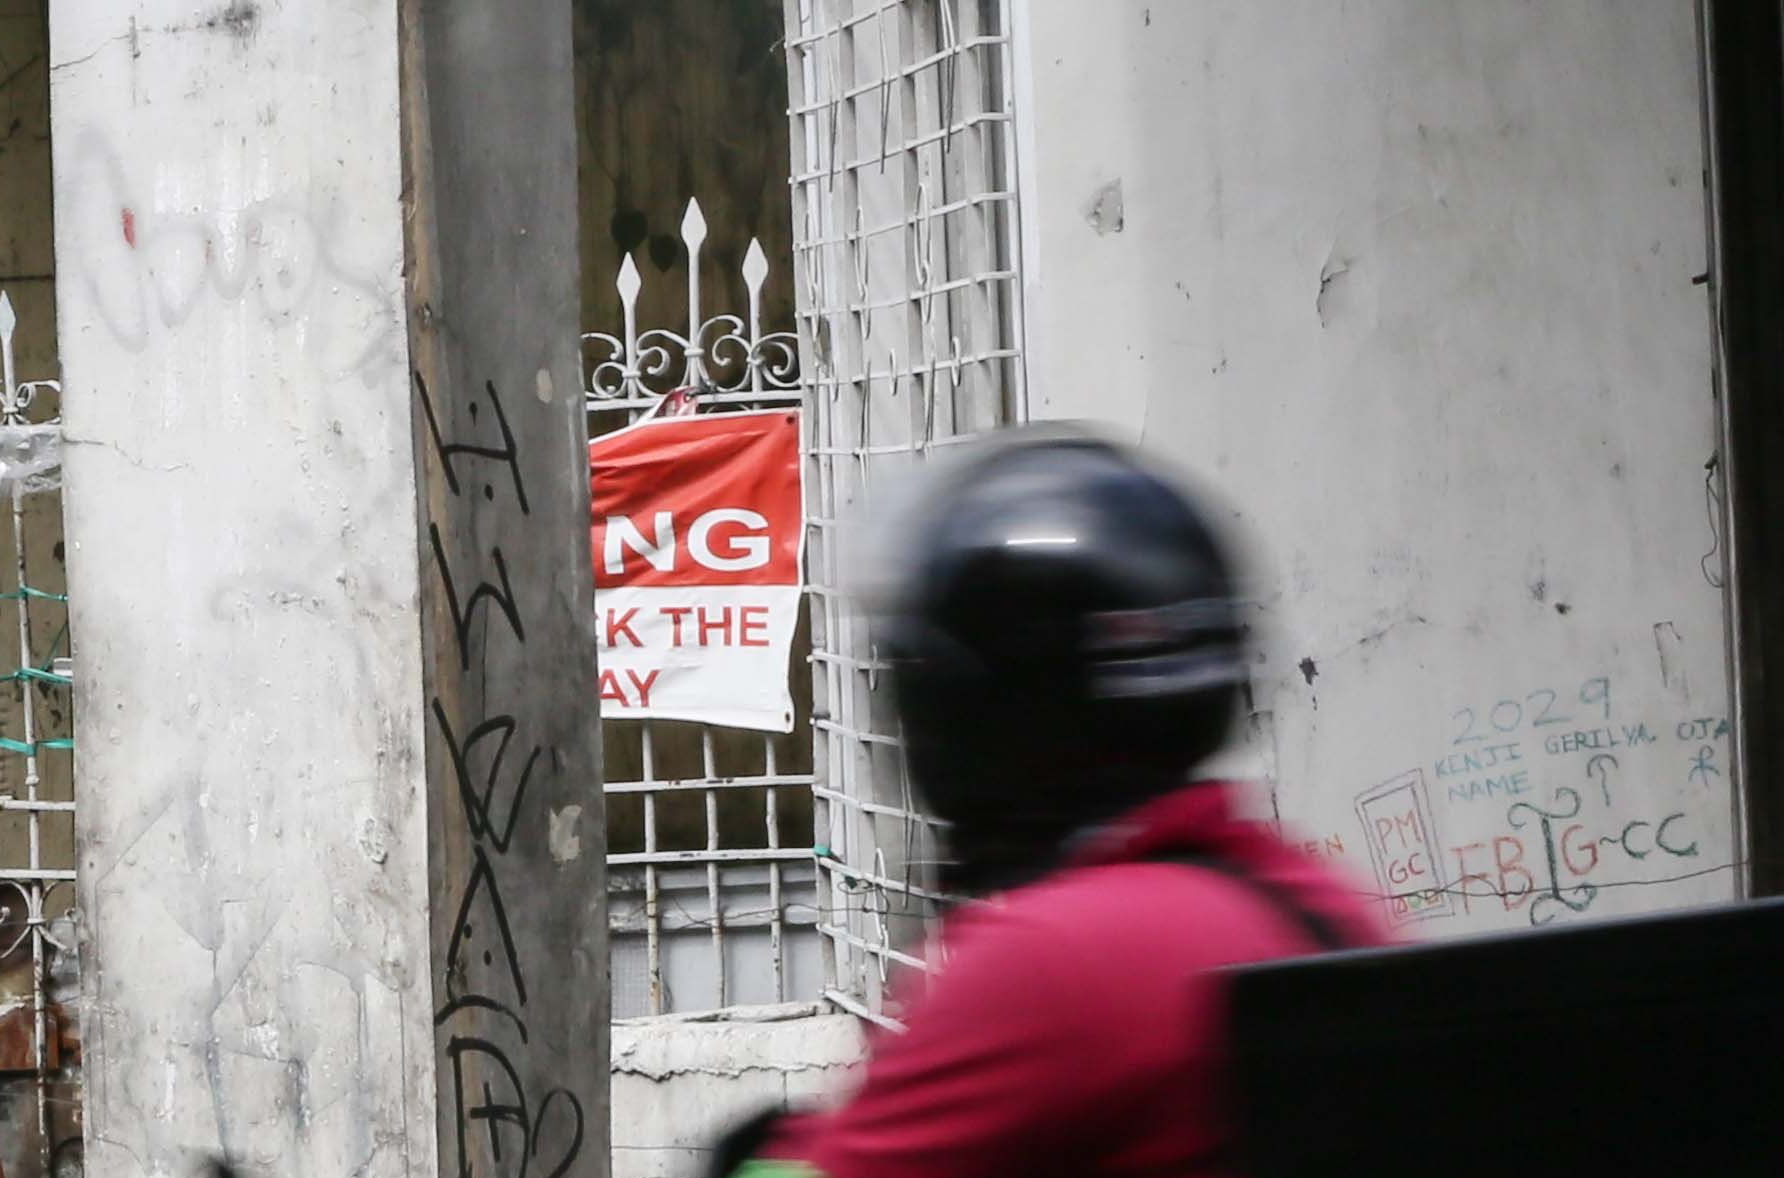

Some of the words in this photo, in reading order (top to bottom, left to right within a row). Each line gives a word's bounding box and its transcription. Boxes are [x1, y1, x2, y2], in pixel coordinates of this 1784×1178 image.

[660, 606, 770, 647] THE
[1451, 676, 1610, 746] 2029
[1447, 770, 1533, 802] NAME
[1375, 809, 1423, 855] PM
[1388, 852, 1425, 879] GC
